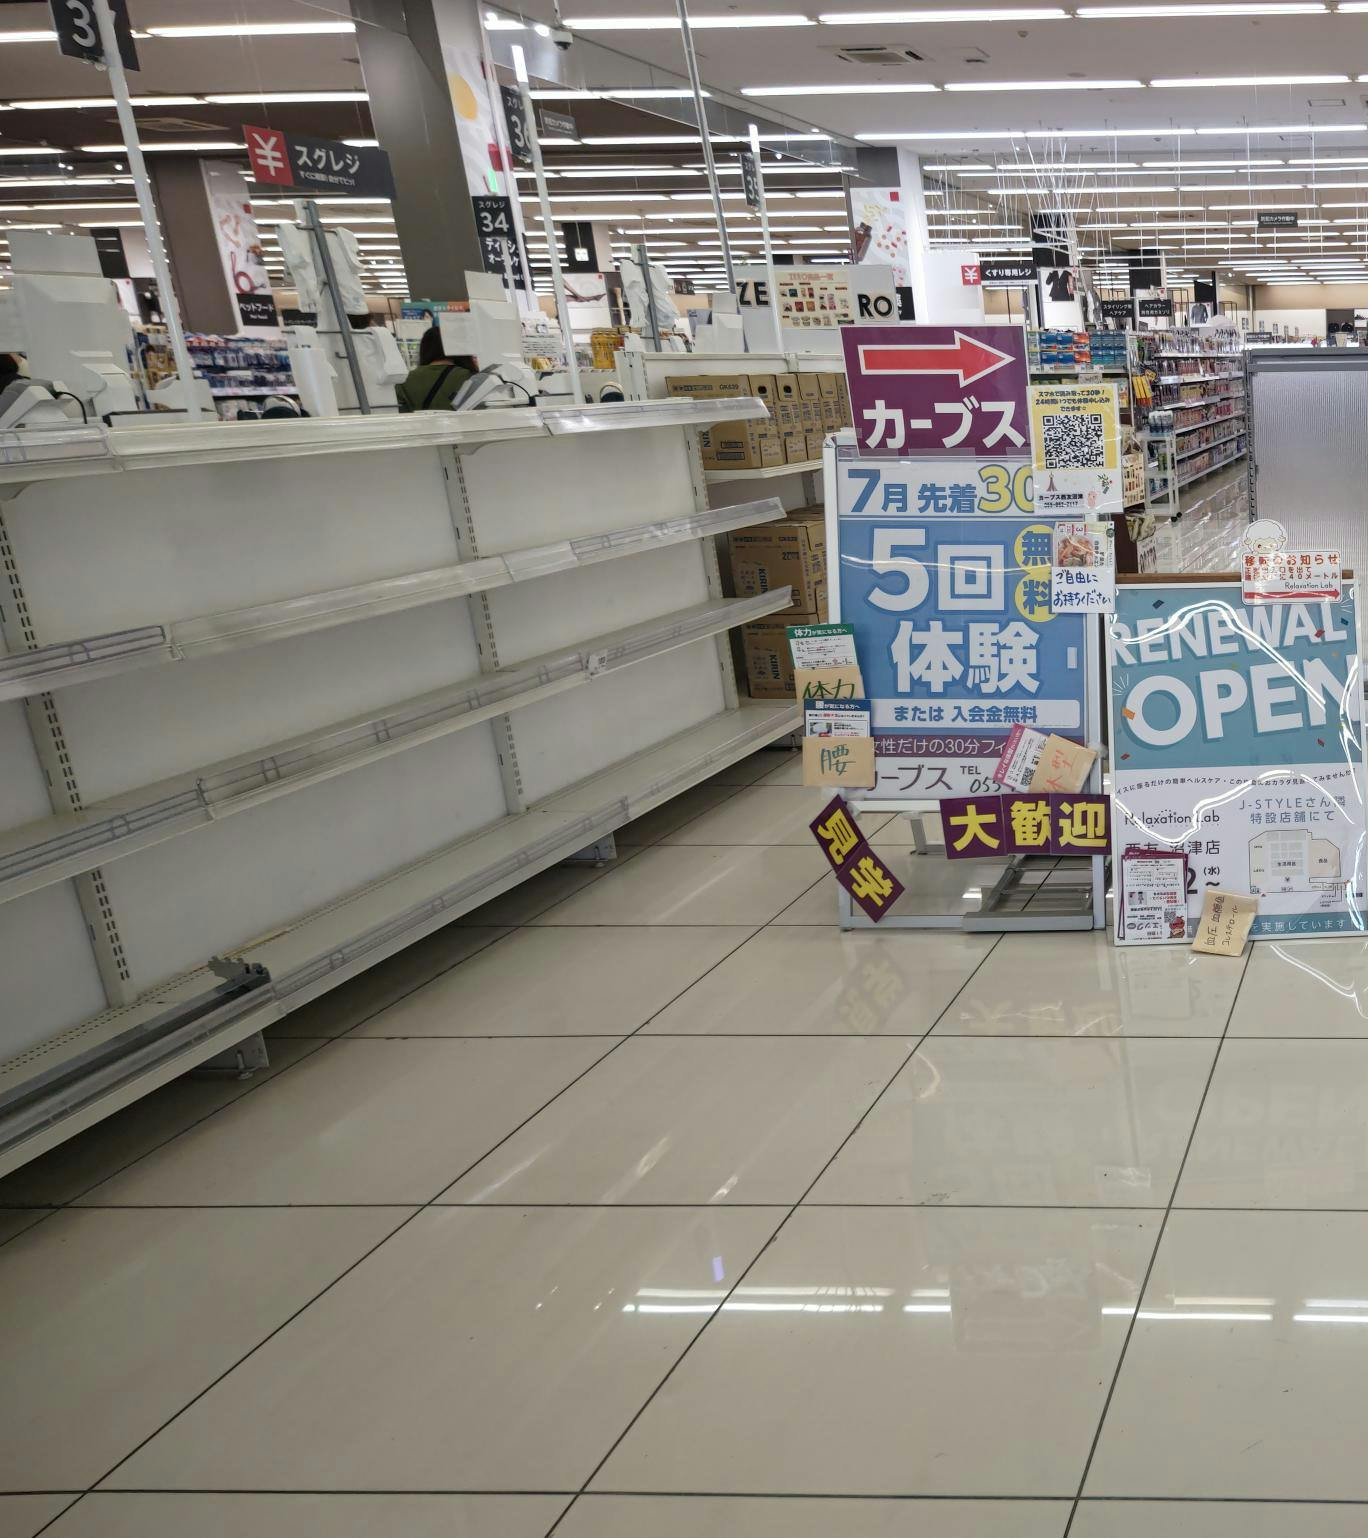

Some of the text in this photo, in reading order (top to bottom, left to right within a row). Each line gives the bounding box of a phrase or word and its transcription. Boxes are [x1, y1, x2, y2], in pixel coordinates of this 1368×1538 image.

[295, 145, 360, 175] スグレジ
[480, 212, 509, 232] 34
[985, 268, 1032, 277] くすり専用レジ
[736, 282, 769, 306] ZE
[857, 294, 893, 318] RO
[240, 303, 274, 312] ペットフード
[863, 396, 1026, 449] カーブス
[848, 469, 908, 514] 7月
[917, 483, 978, 514] 先着
[867, 528, 1005, 612] 5回
[1055, 569, 1099, 585] ご自由に
[1285, 581, 1333, 590] Relaxation Lab
[1053, 589, 1112, 607] お持ちください
[1110, 603, 1348, 666] RENEWAL
[890, 620, 1040, 695] 体験
[803, 678, 855, 699] 体力
[1126, 654, 1361, 746] OPEN
[894, 705, 1038, 723] または 入会金無料
[820, 743, 856, 776] 腰
[960, 765, 981, 775] TEL
[867, 764, 953, 792] ーブス
[949, 801, 1108, 852] 大歓迎
[1125, 811, 1191, 825] Rlaxation
[1250, 810, 1336, 825] 特設店舗にて
[817, 808, 893, 907] 見学
